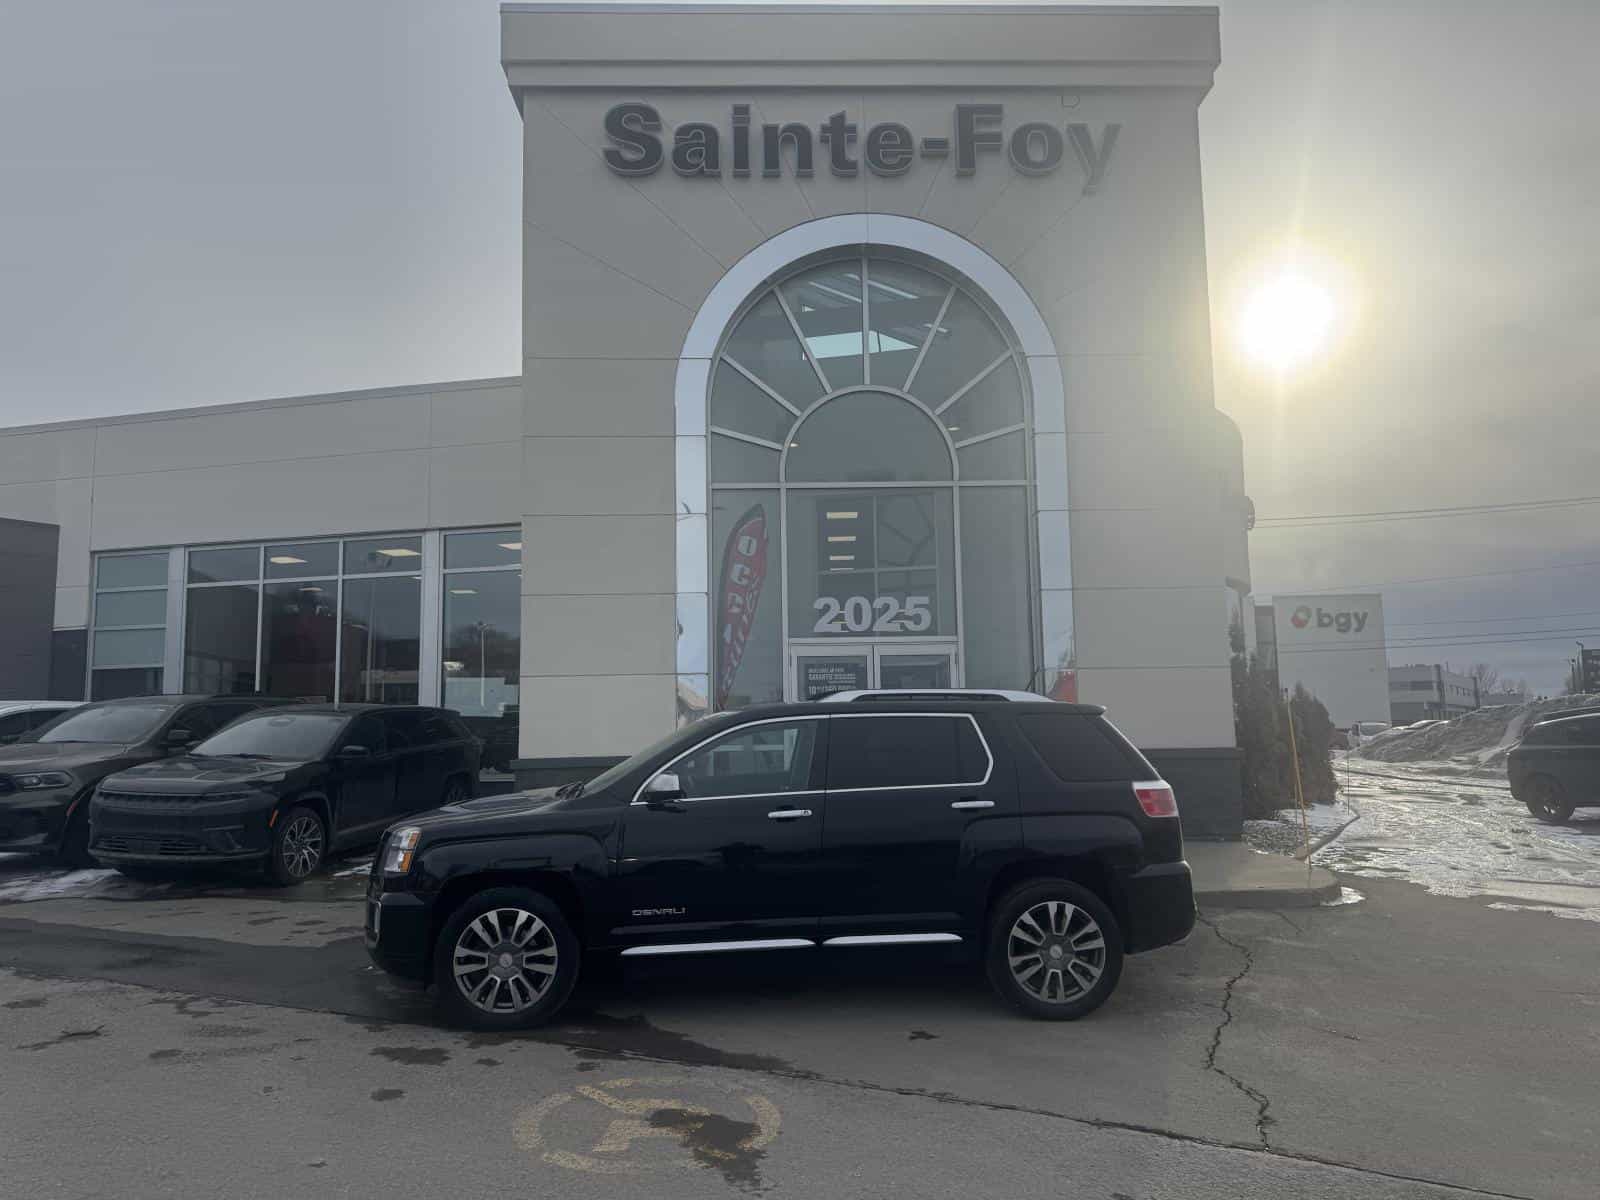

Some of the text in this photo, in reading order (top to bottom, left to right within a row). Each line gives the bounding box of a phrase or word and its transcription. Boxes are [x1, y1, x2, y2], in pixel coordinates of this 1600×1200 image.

[602, 102, 1122, 194] Sainte-Foy
[813, 596, 932, 632] 2025
[1316, 608, 1368, 632] bgy
[632, 907, 686, 916] DENALI
